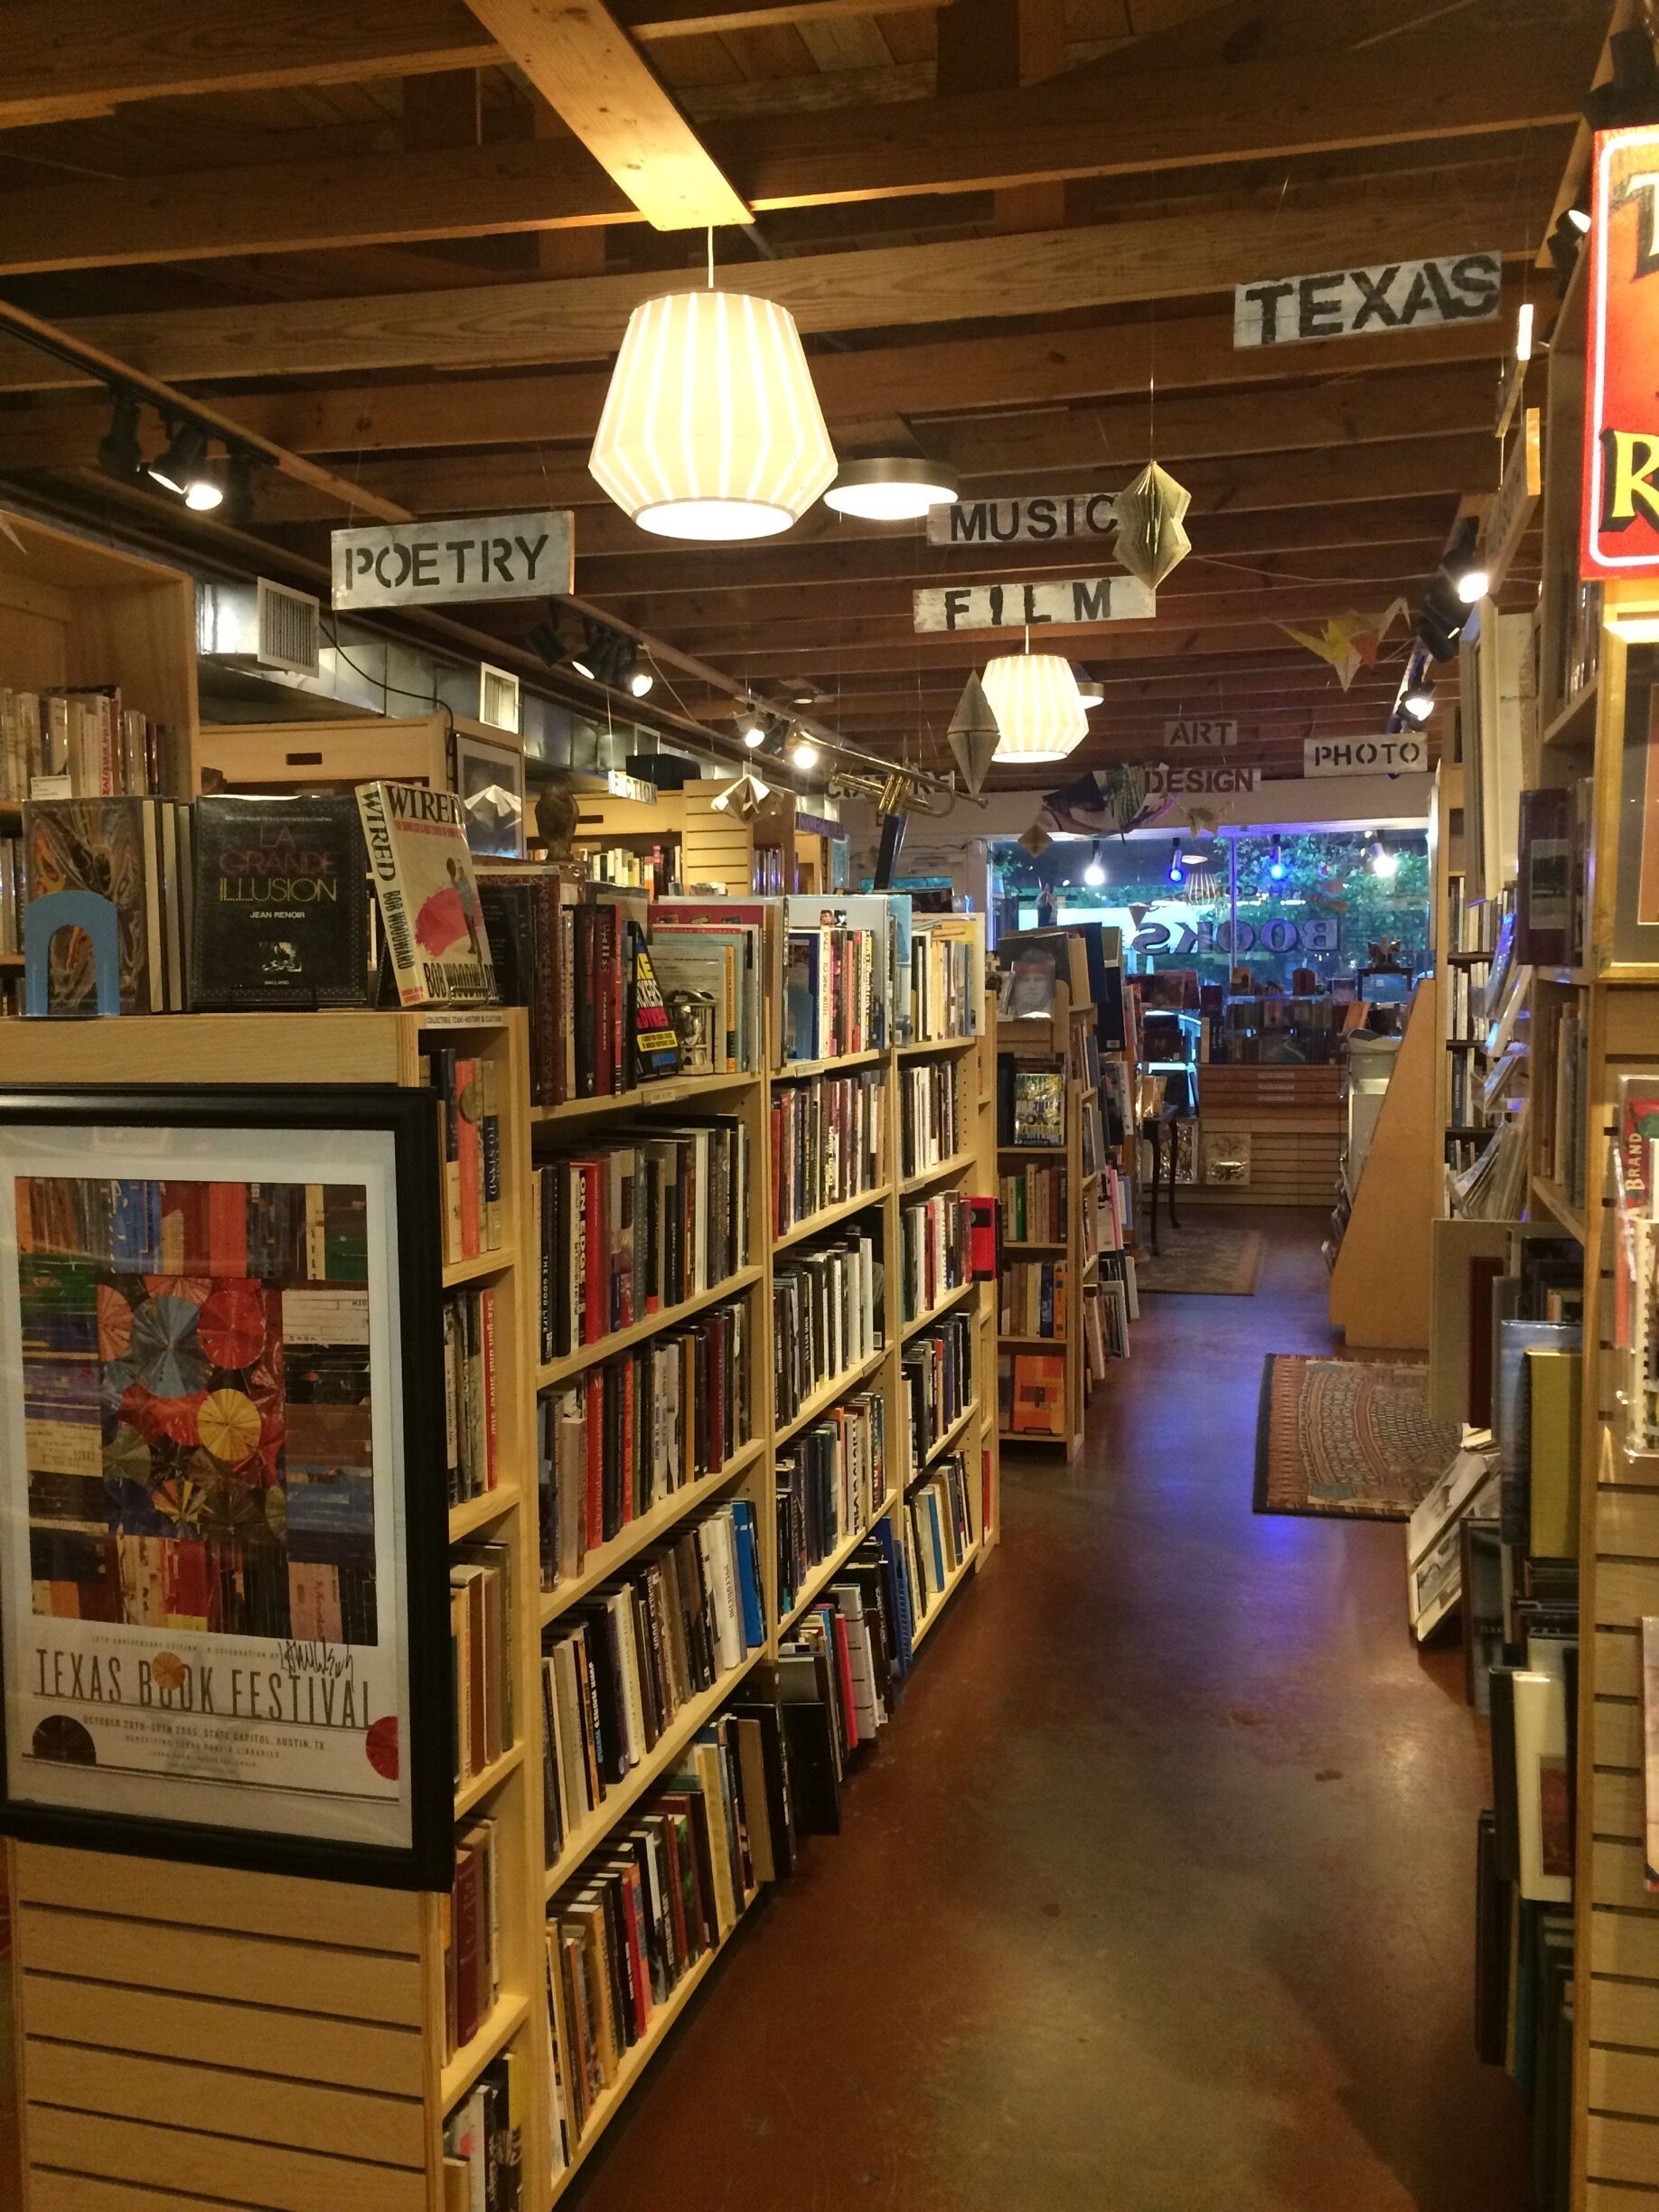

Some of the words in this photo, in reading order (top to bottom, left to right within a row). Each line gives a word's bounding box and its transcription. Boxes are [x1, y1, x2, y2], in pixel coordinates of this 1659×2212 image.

[1246, 258, 1500, 346] TEXAS
[950, 493, 1120, 543] MUSIC
[345, 534, 549, 591] POETRY
[945, 579, 1111, 630] FILM
[1169, 721, 1233, 747] ART
[1314, 739, 1421, 767] PHOTO
[614, 773, 657, 804] FICTION
[1144, 766, 1254, 793] DESIGN
[386, 785, 464, 826] WIRED
[259, 825, 295, 848] LA
[361, 791, 397, 882] WIRED
[220, 850, 338, 875] GRANDE
[220, 877, 337, 902] ILLUSION
[382, 890, 403, 914] BOB
[249, 911, 272, 919] JEAN
[274, 911, 305, 919] RENOIR
[387, 911, 415, 970] WOODWARD
[423, 961, 447, 998] BOB
[452, 1016, 464, 1024] TEXAS
[488, 1126, 495, 1144] TO
[488, 1149, 496, 1195] STAND
[1625, 1132, 1645, 1191] BRAND
[36, 1649, 122, 1704] TEXAS
[231, 1669, 371, 1729] FESTIVAL
[83, 1714, 121, 1729] OCTOBER
[203, 1729, 230, 1740] STATE
[314, 1740, 325, 1751] TX
